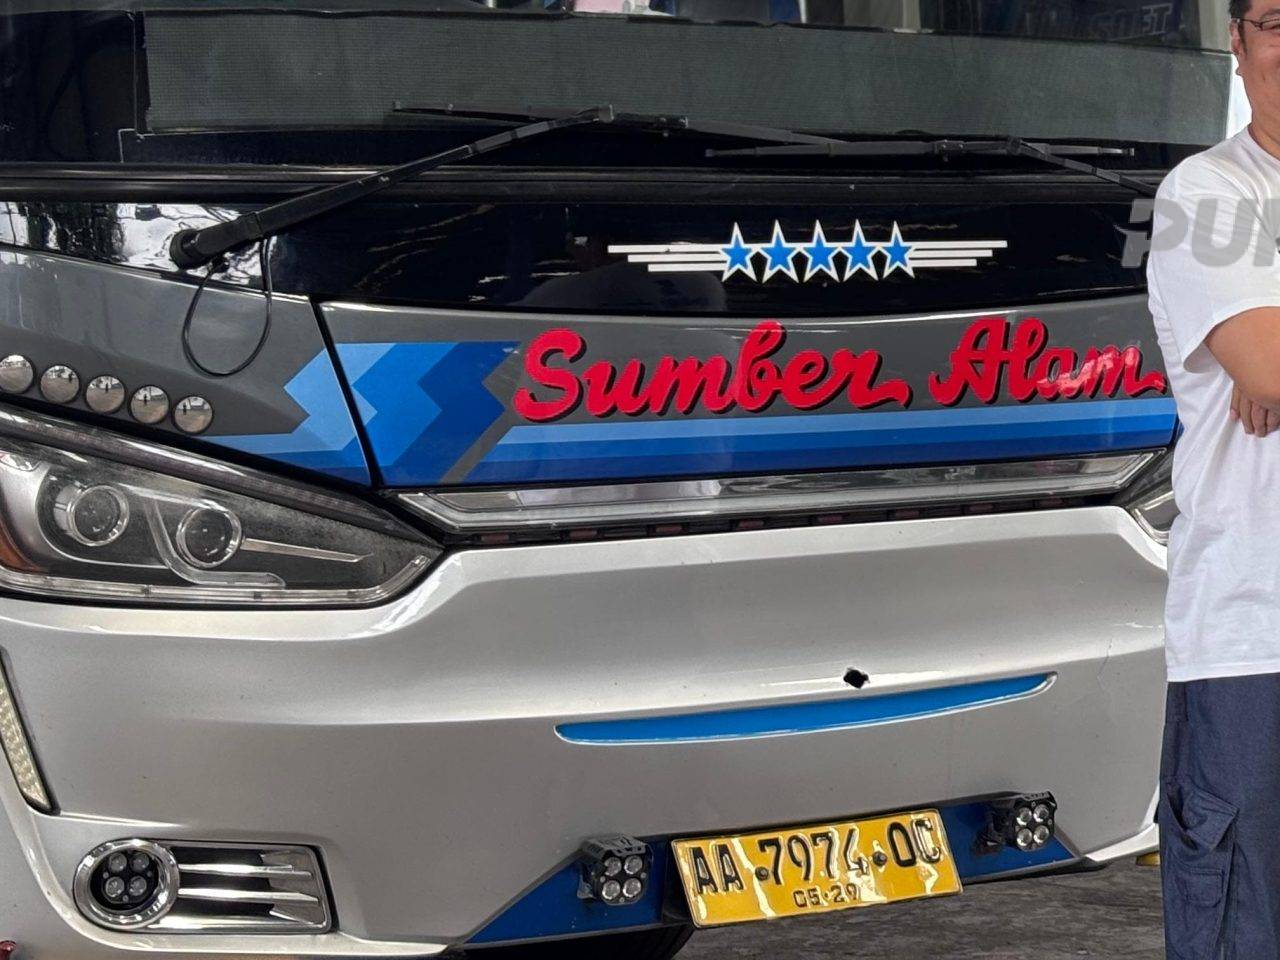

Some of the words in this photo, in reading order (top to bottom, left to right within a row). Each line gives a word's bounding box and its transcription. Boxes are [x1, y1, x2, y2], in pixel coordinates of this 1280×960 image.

[514, 320, 913, 424] Sumber
[927, 317, 1168, 403] Alam
[689, 844, 745, 895] AA
[757, 826, 869, 886] 7974
